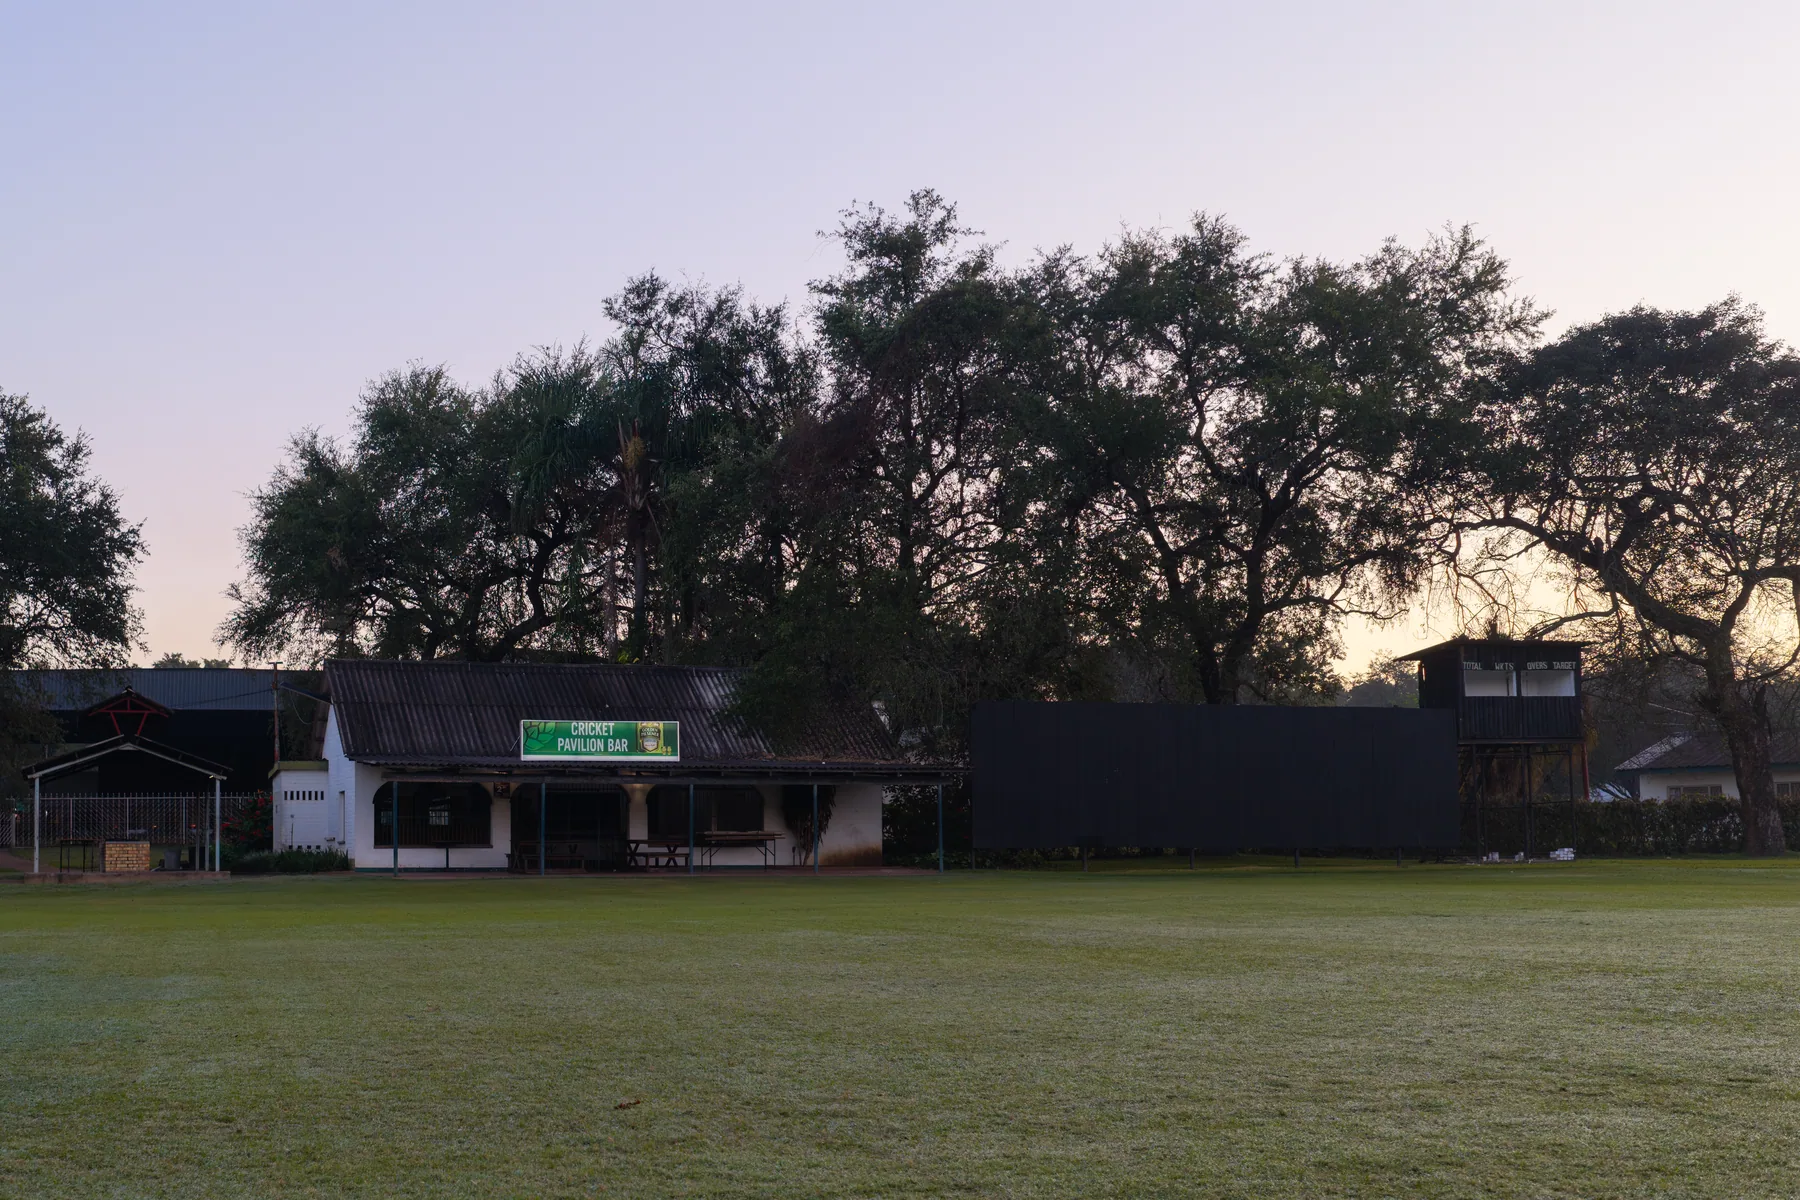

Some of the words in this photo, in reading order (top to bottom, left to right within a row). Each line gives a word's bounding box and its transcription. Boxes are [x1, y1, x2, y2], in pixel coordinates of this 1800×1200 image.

[1463, 661, 1482, 670] TOTAL
[1495, 662, 1514, 670] WKTS
[1527, 661, 1548, 670] OVERS
[1553, 661, 1576, 670] TARGET
[571, 722, 615, 736] CRICKET
[557, 738, 604, 752] PAVILION
[608, 740, 628, 752] BAR
